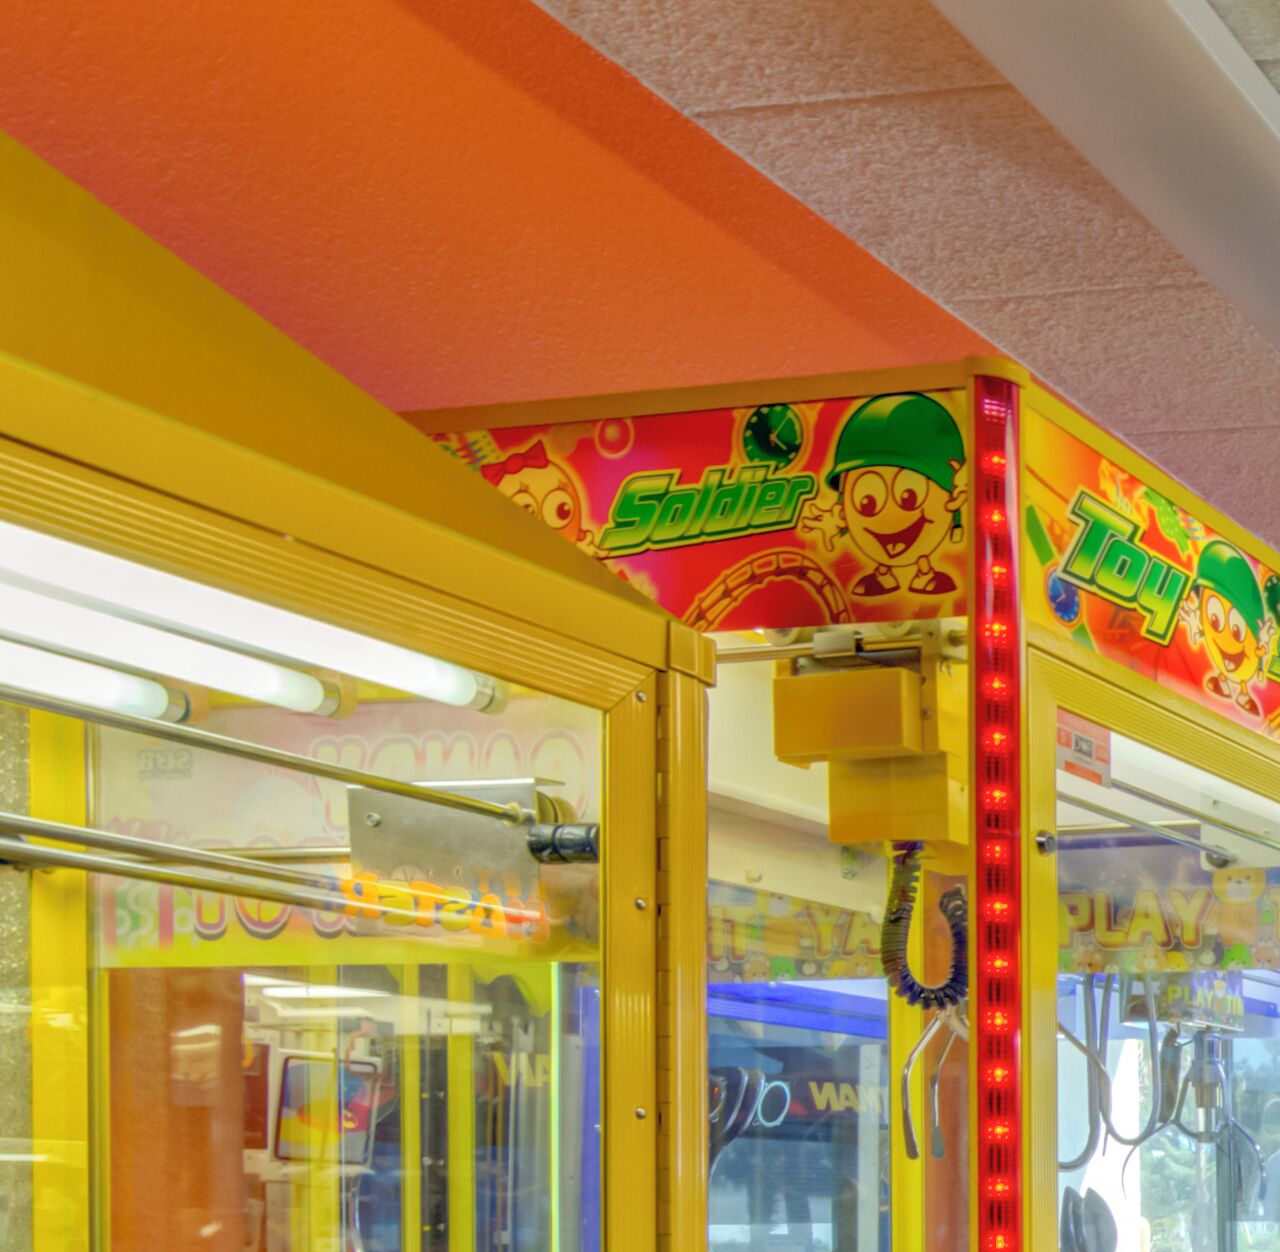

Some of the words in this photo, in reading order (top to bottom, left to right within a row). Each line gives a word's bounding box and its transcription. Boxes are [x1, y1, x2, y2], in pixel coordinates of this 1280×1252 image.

[600, 464, 817, 555] Soldier
[1060, 489, 1192, 643] Toy
[1058, 888, 1211, 948] PLAY
